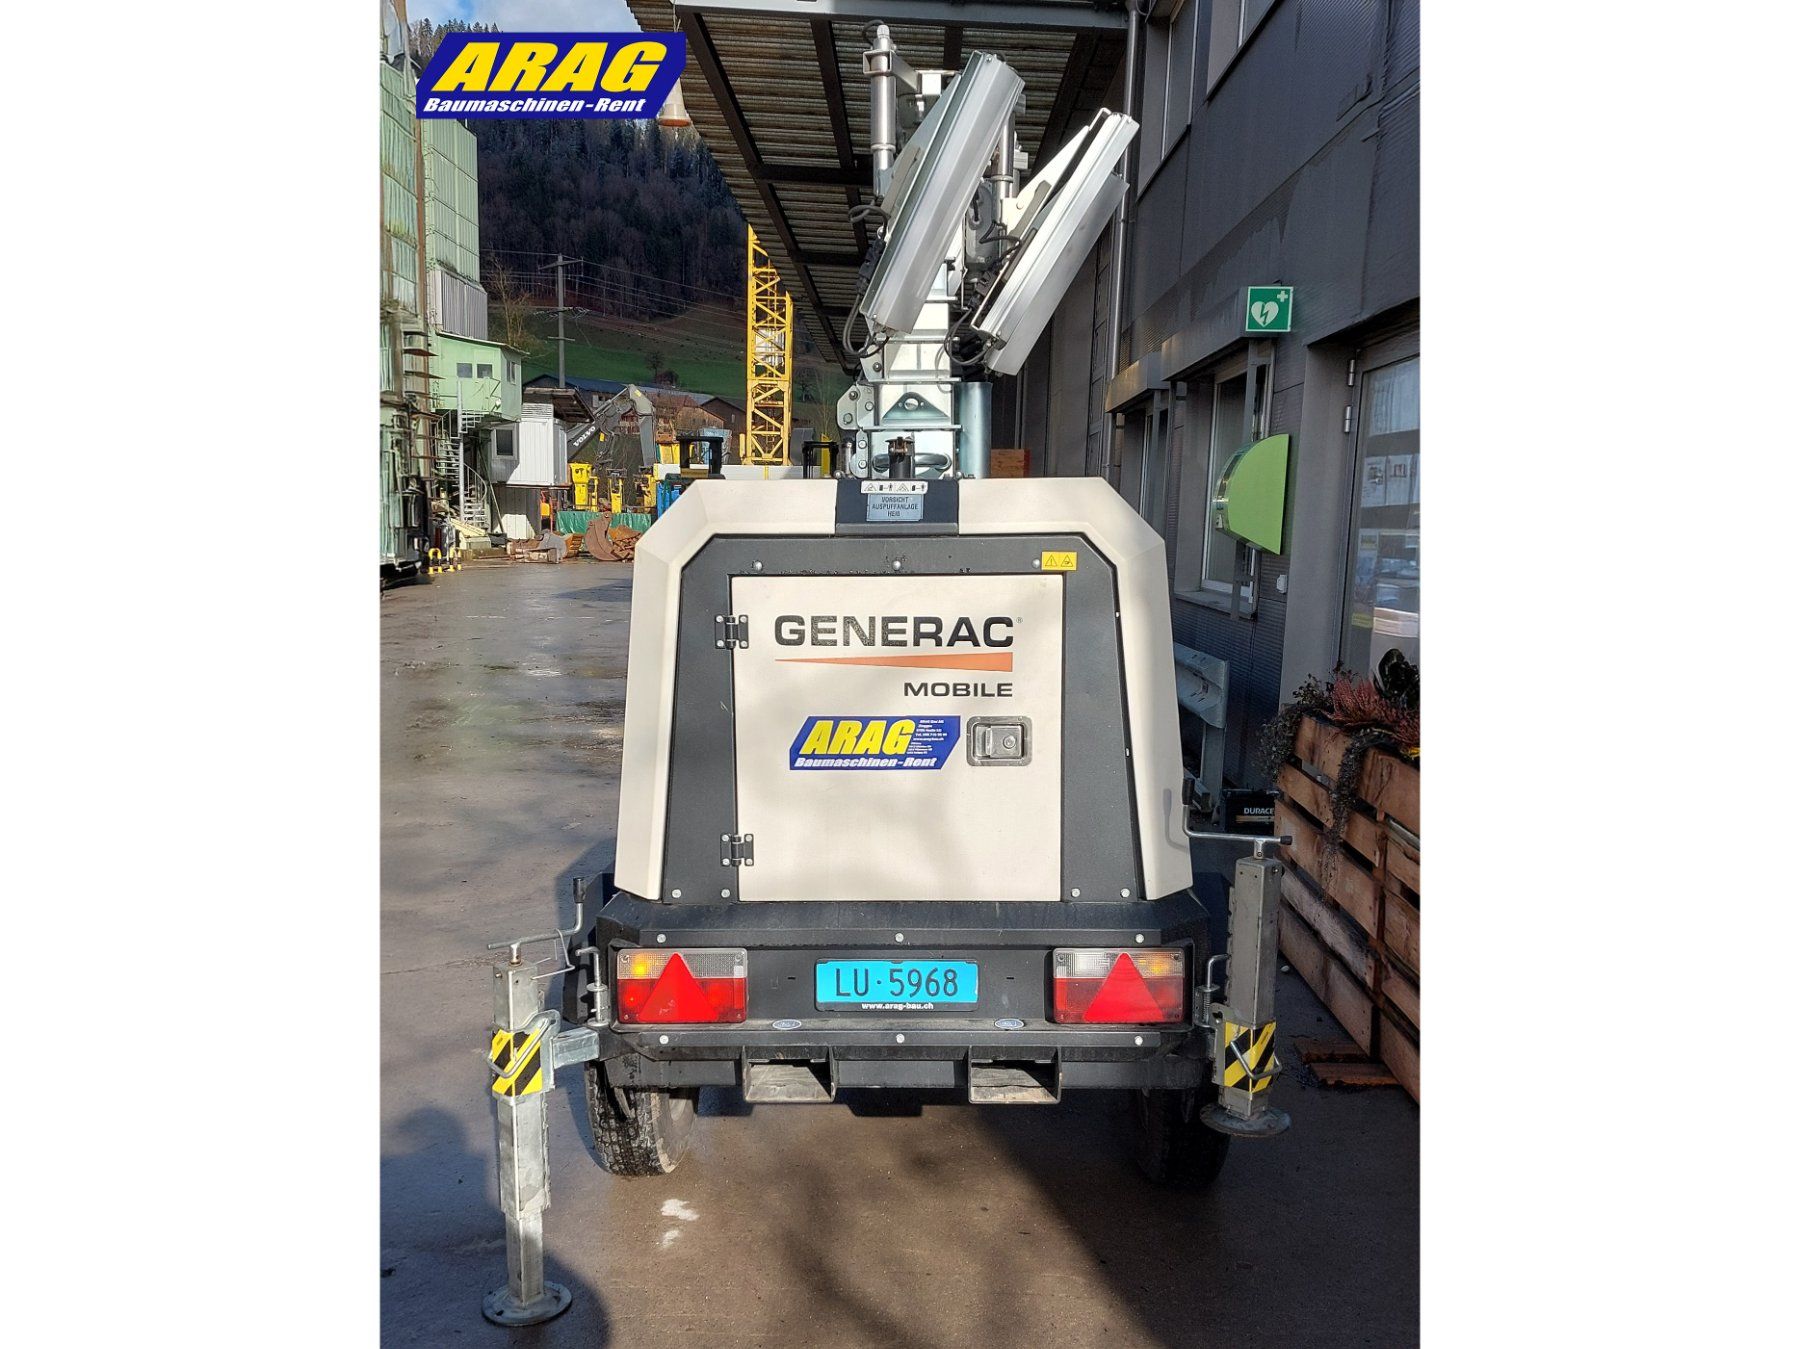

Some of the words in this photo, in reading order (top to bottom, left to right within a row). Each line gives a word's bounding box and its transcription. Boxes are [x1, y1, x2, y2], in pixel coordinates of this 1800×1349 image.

[573, 426, 596, 447] VOLVO
[774, 615, 1014, 648] GENERAC
[903, 682, 1013, 698] MOBILE
[799, 719, 916, 756] ARAG
[861, 1002, 934, 1011] www.arag-bau.ch
